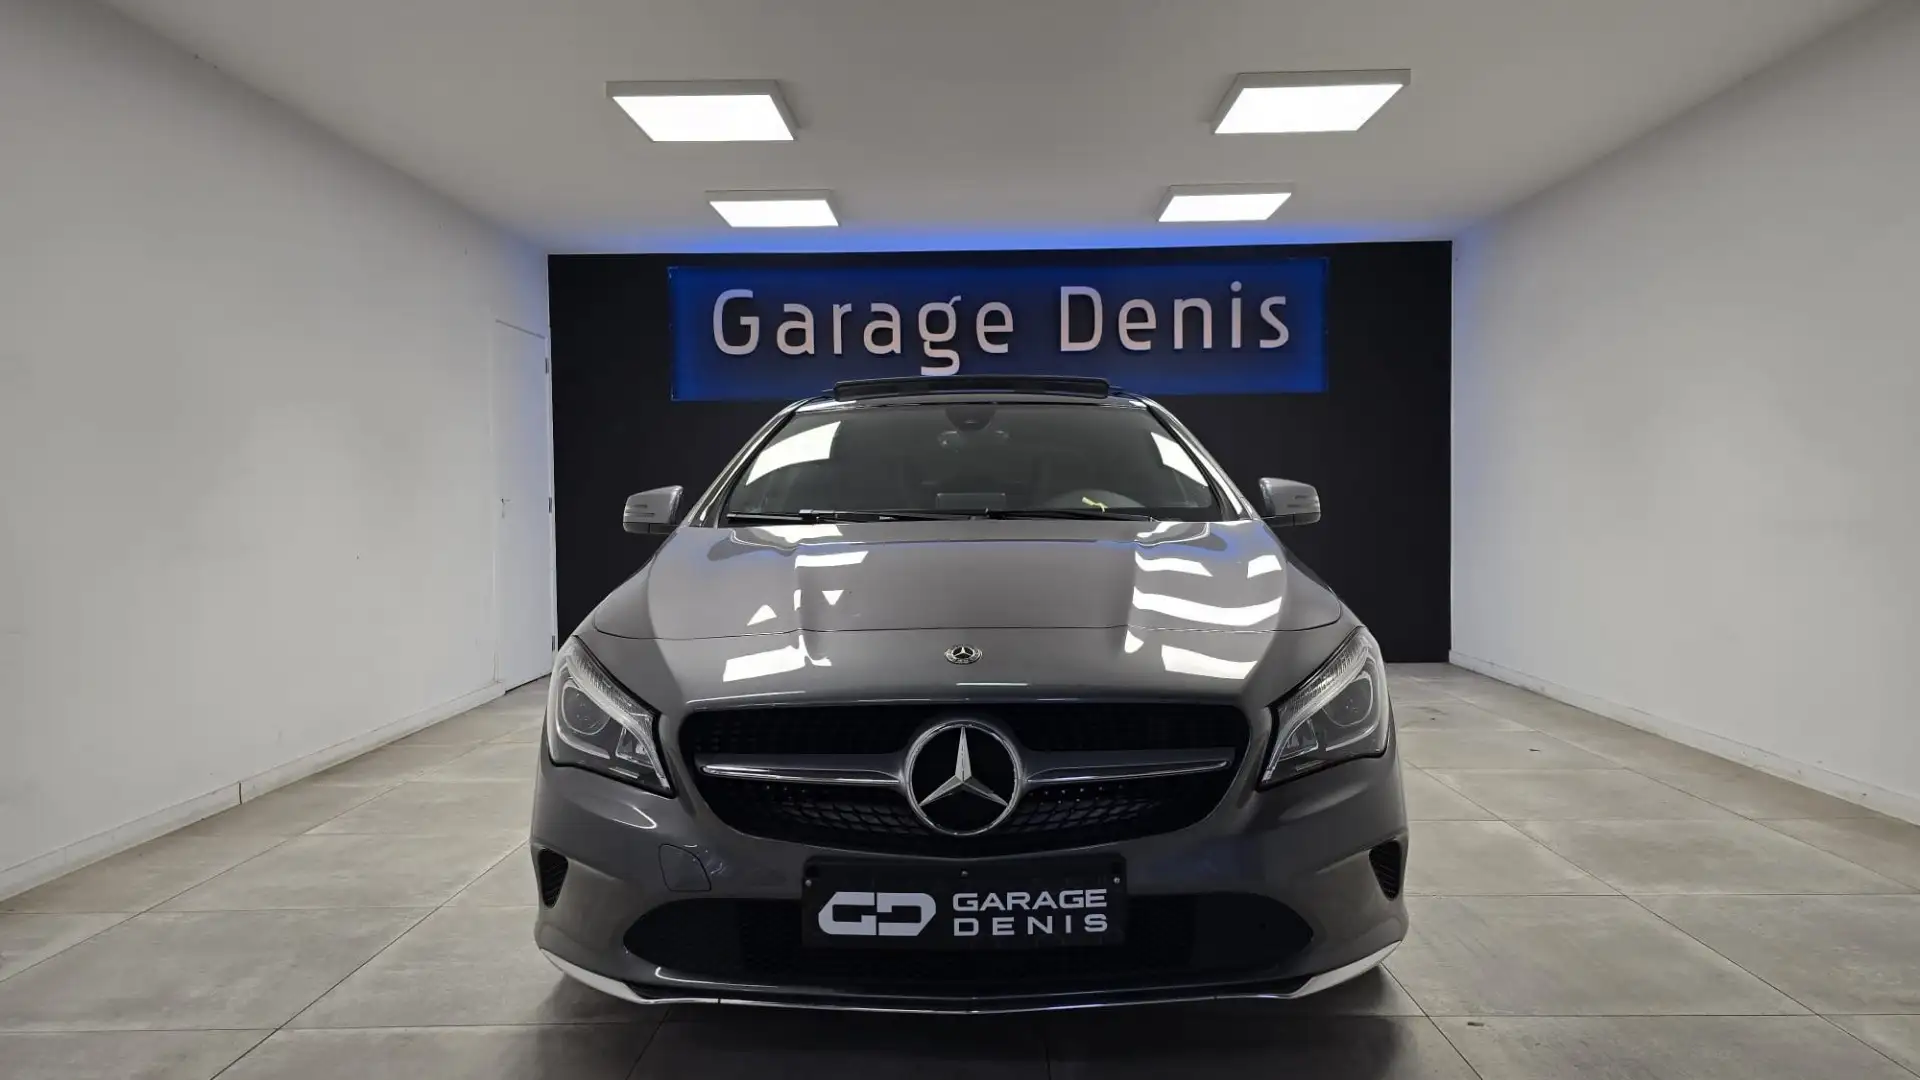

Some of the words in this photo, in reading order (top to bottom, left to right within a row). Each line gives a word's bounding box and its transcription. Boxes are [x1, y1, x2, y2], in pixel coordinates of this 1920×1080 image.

[711, 287, 1014, 376] Garage
[1059, 280, 1290, 353] Denis
[952, 888, 1107, 912] GARAGE
[953, 913, 1108, 937] DENIS
